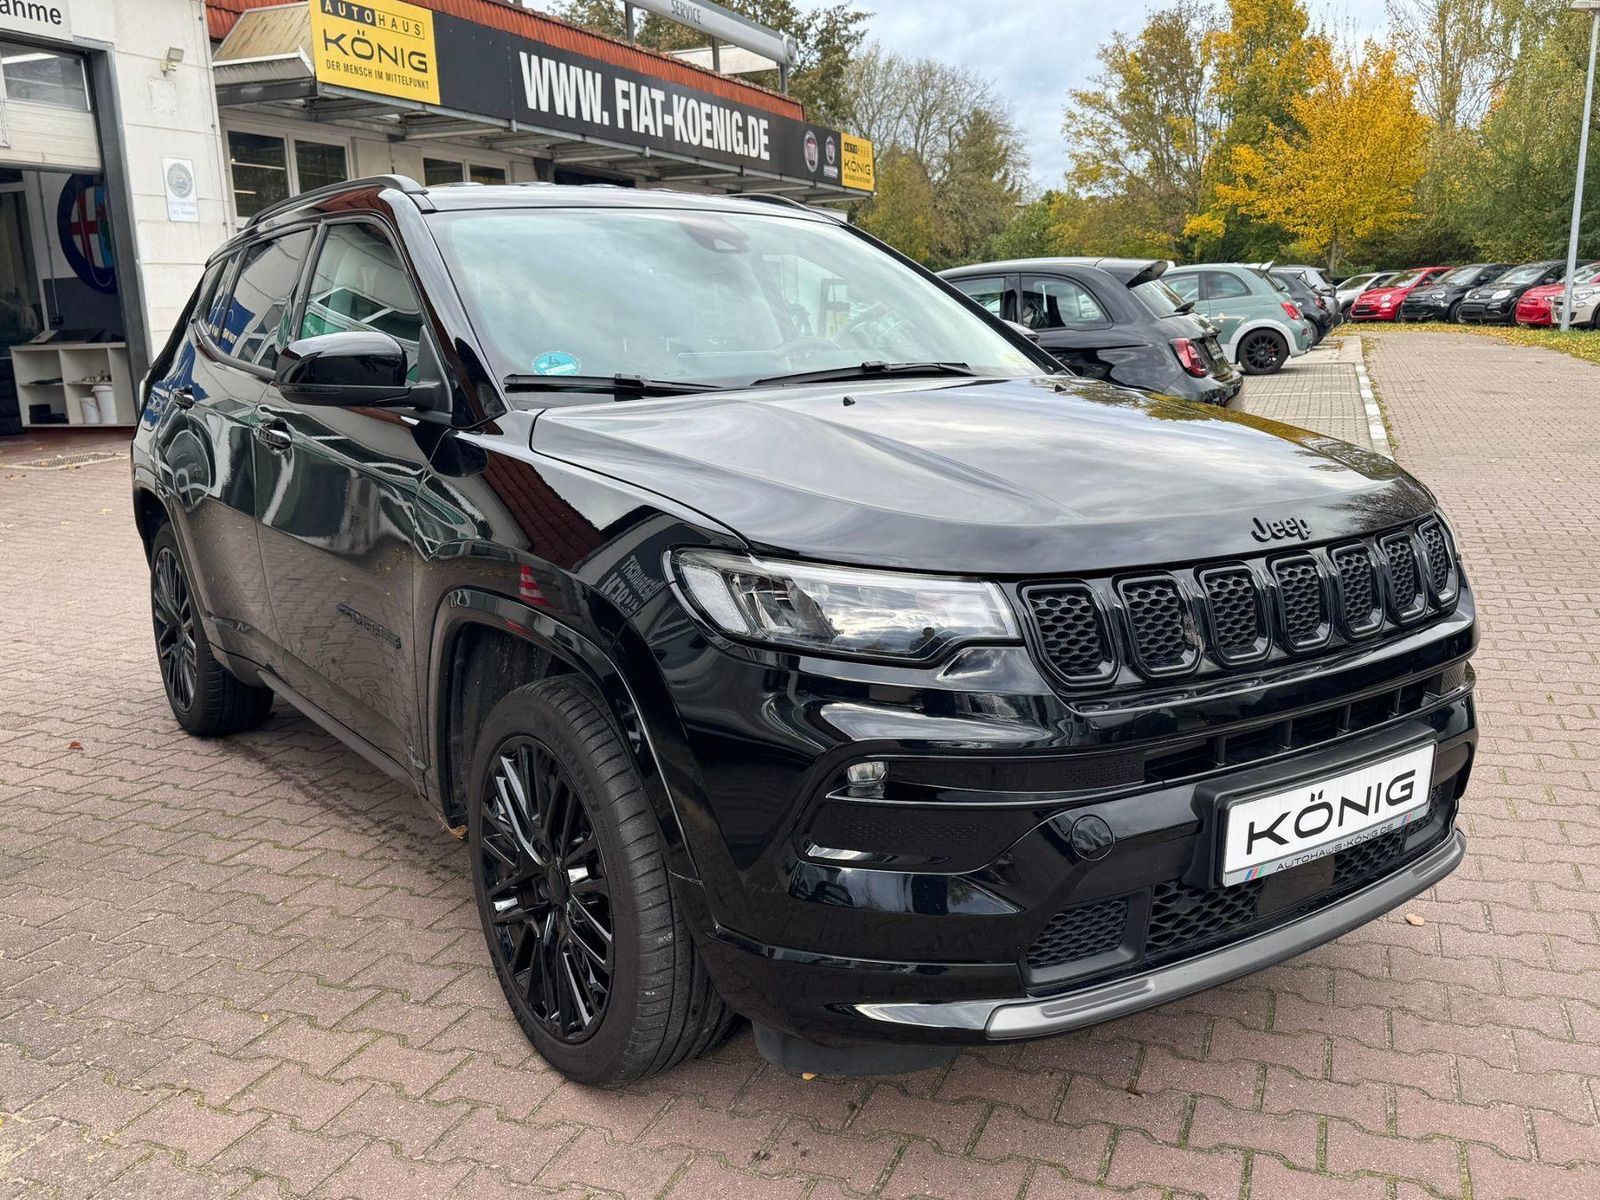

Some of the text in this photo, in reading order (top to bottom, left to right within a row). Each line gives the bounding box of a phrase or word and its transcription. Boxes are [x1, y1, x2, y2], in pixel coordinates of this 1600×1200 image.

[671, 0, 702, 24] SERVICE
[323, 29, 428, 73] KÖNIG
[326, 59, 430, 90] DER MENSCH IM MITTELPUNKT
[614, 78, 771, 161] FIAT-KOENIG.DE
[1251, 517, 1311, 542] Jeep
[1246, 769, 1416, 855] KÖNIG
[1276, 823, 1394, 871] AUTOHAUS-KÖNIGDE
